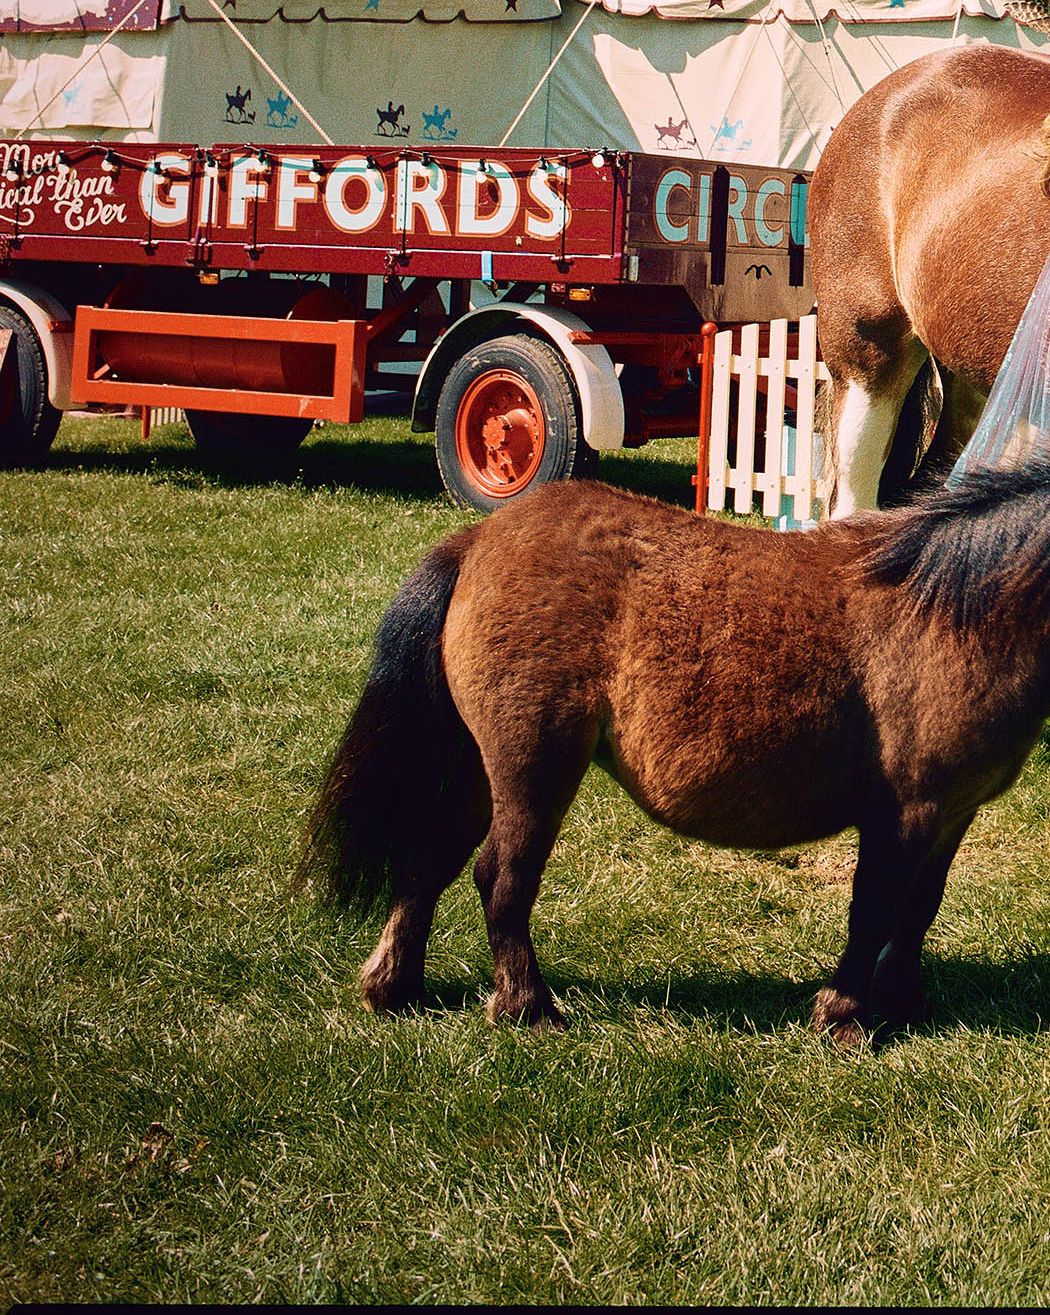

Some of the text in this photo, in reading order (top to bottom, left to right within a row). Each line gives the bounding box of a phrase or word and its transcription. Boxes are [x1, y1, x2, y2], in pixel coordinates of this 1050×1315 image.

[0, 143, 62, 179] Mor
[46, 168, 115, 201] than
[138, 151, 573, 241] GIFFORDS
[54, 197, 127, 231] Ever
